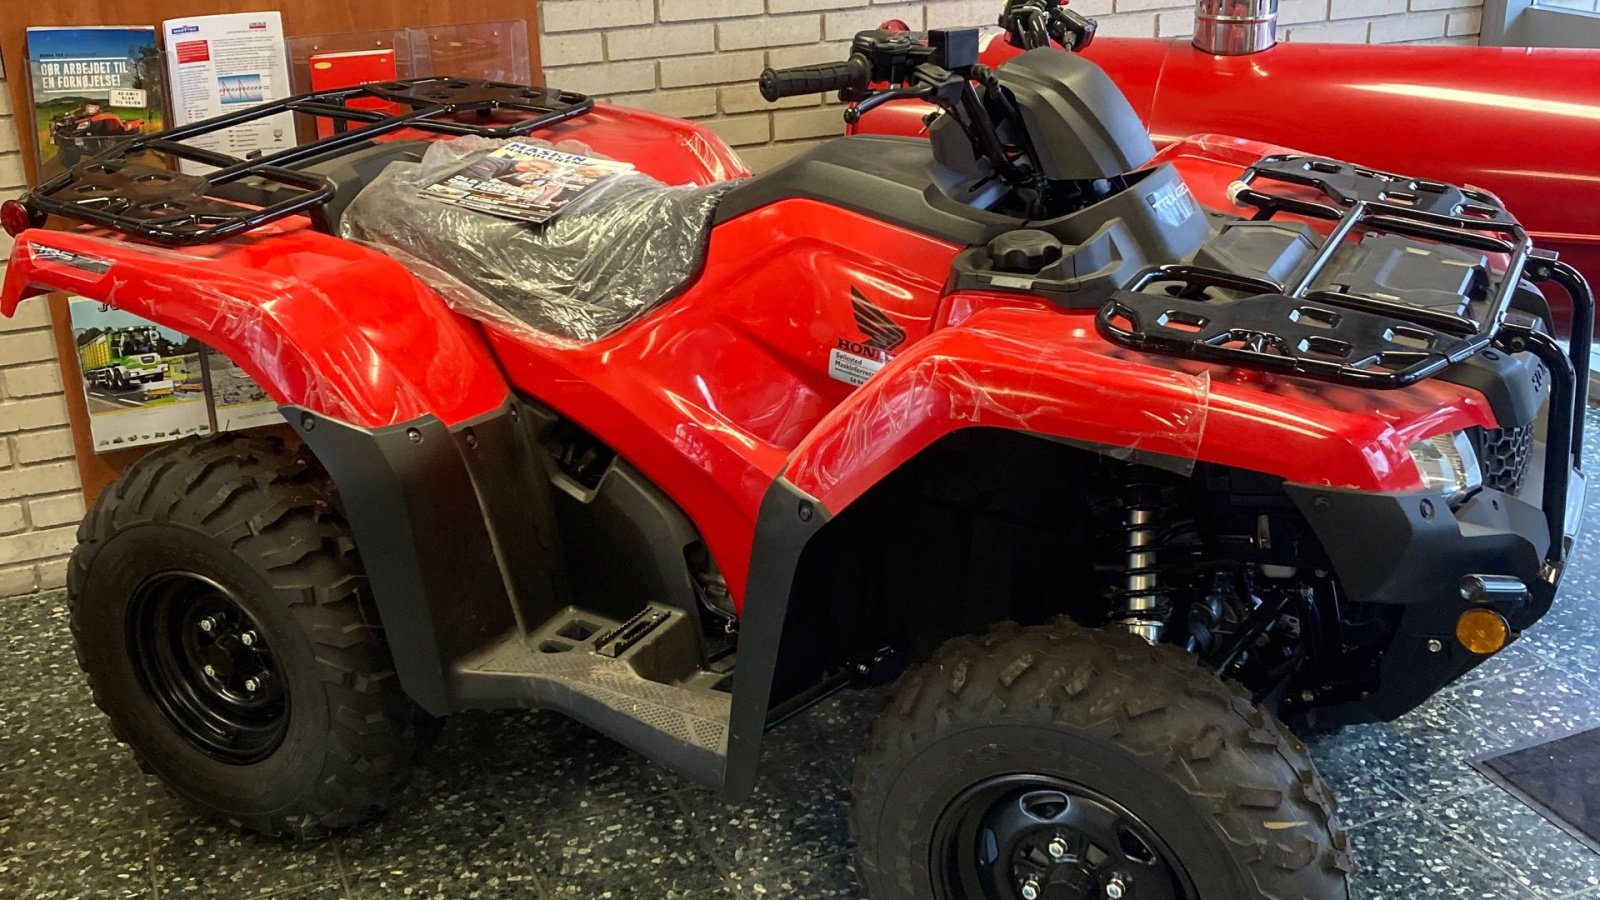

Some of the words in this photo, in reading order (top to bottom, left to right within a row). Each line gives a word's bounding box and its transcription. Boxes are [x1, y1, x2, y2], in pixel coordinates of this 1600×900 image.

[41, 63, 60, 76] GØR
[63, 62, 110, 75] ARBEJDET
[113, 61, 128, 73] TIL
[43, 77, 54, 88] EN
[58, 75, 120, 88] FORNØJELSE!
[510, 143, 586, 162] MASKIN
